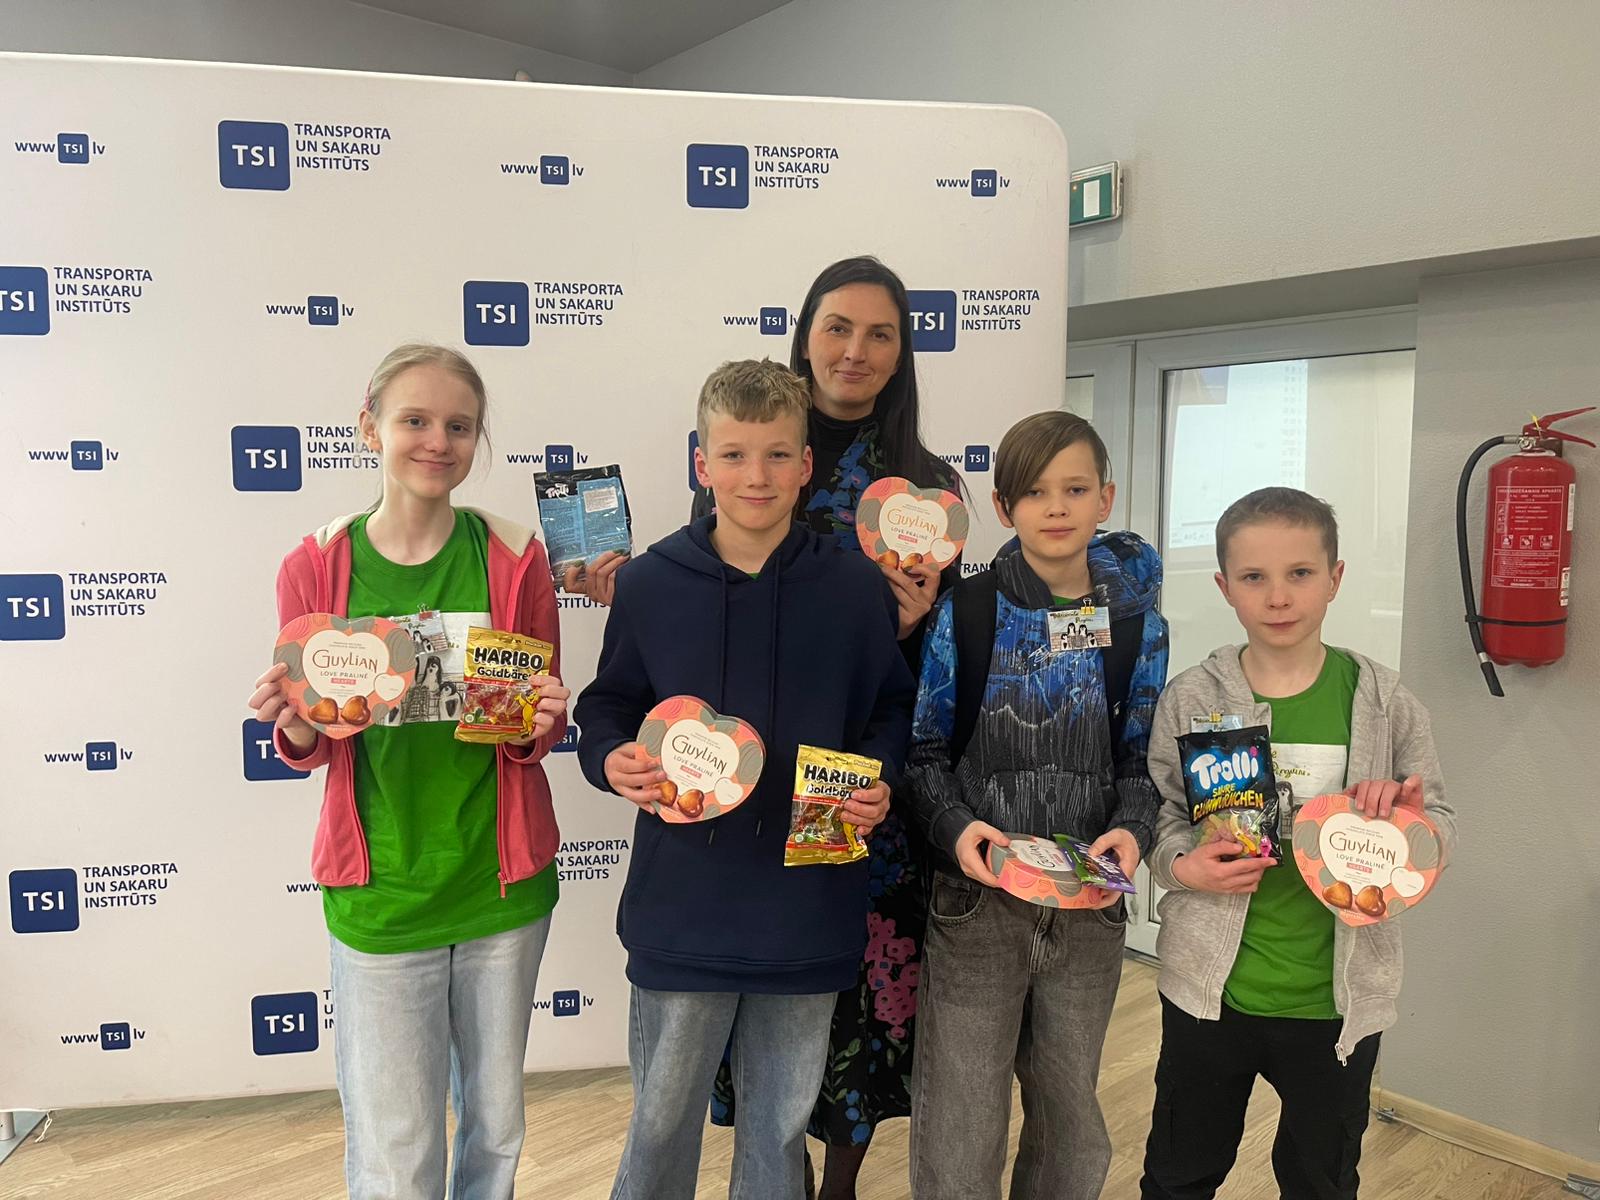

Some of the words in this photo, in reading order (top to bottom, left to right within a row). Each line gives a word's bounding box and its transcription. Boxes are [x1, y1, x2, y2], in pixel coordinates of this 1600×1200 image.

[294, 123, 391, 140] TRANSPORTA
[15, 142, 55, 153] www
[63, 143, 83, 154] TSI
[93, 141, 105, 154] lv
[296, 140, 317, 152] UN
[322, 141, 380, 155] SAKARU
[754, 145, 839, 159] TRANSPORTA
[232, 145, 275, 167] TSI
[296, 156, 369, 171] INSTITŪTS
[501, 164, 538, 174] www
[546, 165, 563, 175] TSI
[572, 164, 584, 176] lv
[755, 161, 774, 172] UN
[778, 162, 829, 174] SAKARU
[698, 166, 736, 187] TSI
[755, 175, 819, 189] INSTITŪTS
[936, 179, 969, 188] www
[976, 179, 992, 188] TSI
[1000, 176, 1010, 188] lv
[54, 267, 153, 281] TRANSPORTA
[55, 283, 77, 295] UN
[82, 284, 142, 297] SAKARU
[534, 282, 623, 295] TRANSPORTA
[962, 290, 1040, 301] TRANSPORTA
[56, 298, 131, 313] INSTITŪTS
[266, 305, 305, 315] www
[313, 306, 332, 315] TSI
[342, 304, 354, 316] lv
[535, 298, 555, 309] UN
[559, 299, 613, 311] SAKARU
[962, 305, 980, 316] UN
[984, 305, 1031, 315] SAKARU
[476, 304, 515, 324] TSI
[536, 312, 603, 326] INSTITŪTS
[723, 316, 758, 325] www
[765, 317, 781, 326] TSI
[910, 312, 944, 330] TSI
[962, 317, 1021, 330] INSTITŪTS
[29, 451, 69, 460] www
[77, 451, 96, 460] TSI
[106, 448, 119, 461] lv
[307, 442, 328, 453] UN
[245, 449, 287, 469] TSI
[507, 455, 543, 463] www
[551, 454, 568, 463] TSI
[577, 452, 588, 464] lv
[969, 454, 985, 463] TSI
[69, 572, 167, 585] TRANSPORTA
[70, 589, 92, 600] UN
[97, 588, 156, 600] SAKARU
[7, 597, 50, 617] TSI
[71, 602, 145, 616] INSTITŪTS
[474, 646, 543, 670] HARIBO
[44, 753, 84, 762] www
[92, 751, 111, 761] TSI
[120, 748, 133, 760] lv
[1190, 746, 1259, 790] Trolli
[804, 764, 871, 789] HARIBO
[558, 839, 629, 853] ANSPORTA
[568, 854, 619, 867] SAKARU
[82, 863, 178, 878] TRANSPORTA
[84, 882, 105, 893] UN
[110, 878, 167, 892] SAKARU
[23, 891, 64, 911] TSI
[85, 893, 157, 908] INSTITŪTS
[558, 999, 574, 1008] TSI
[583, 995, 594, 1007] lv
[264, 1013, 304, 1034] TSI
[61, 1034, 99, 1044] www
[106, 1032, 124, 1041] TSI
[133, 1028, 145, 1039] lv
